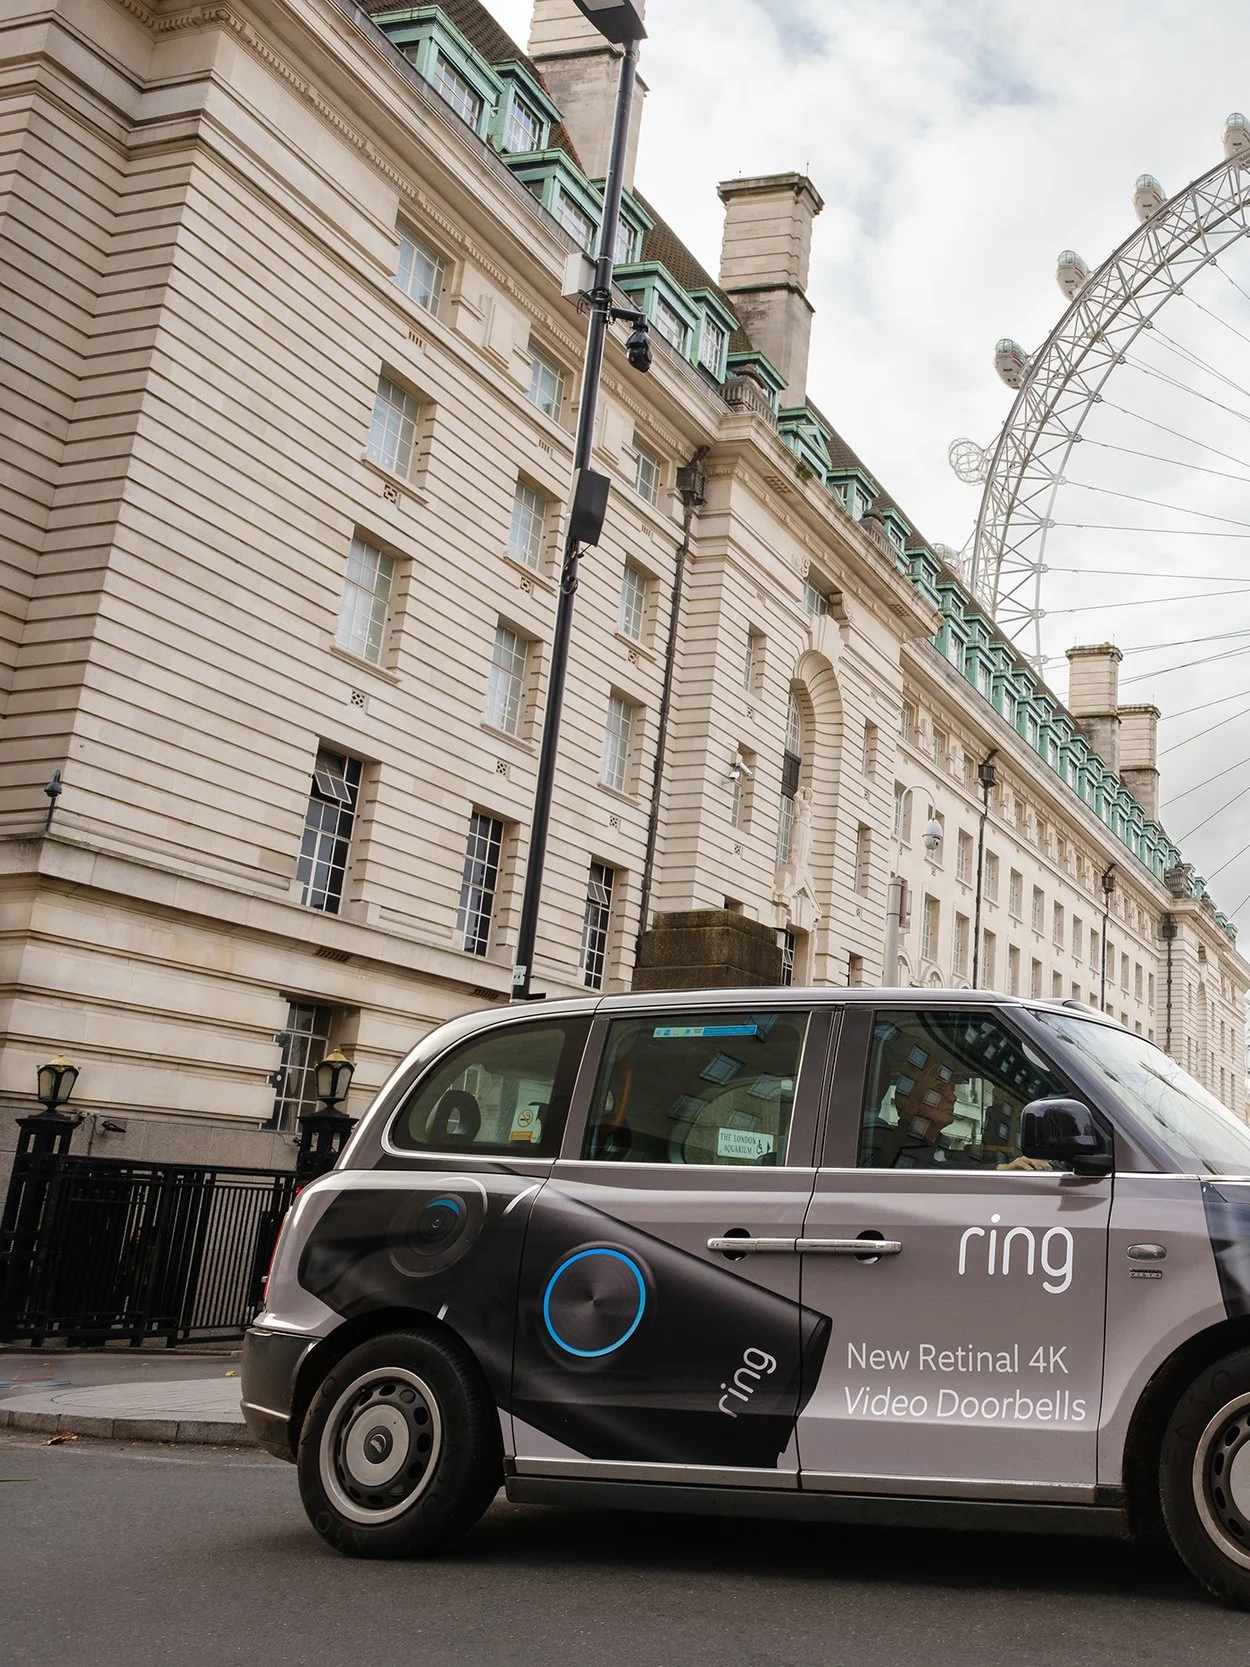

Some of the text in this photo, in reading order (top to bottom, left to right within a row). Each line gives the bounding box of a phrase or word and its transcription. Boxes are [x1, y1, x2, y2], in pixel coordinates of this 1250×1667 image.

[720, 1132, 757, 1145] THE LONDON
[958, 1213, 1074, 1294] ring
[847, 1342, 1069, 1374] New Retinal 4K
[718, 1347, 777, 1418] ring
[844, 1386, 1087, 1422] Video Doorbells
